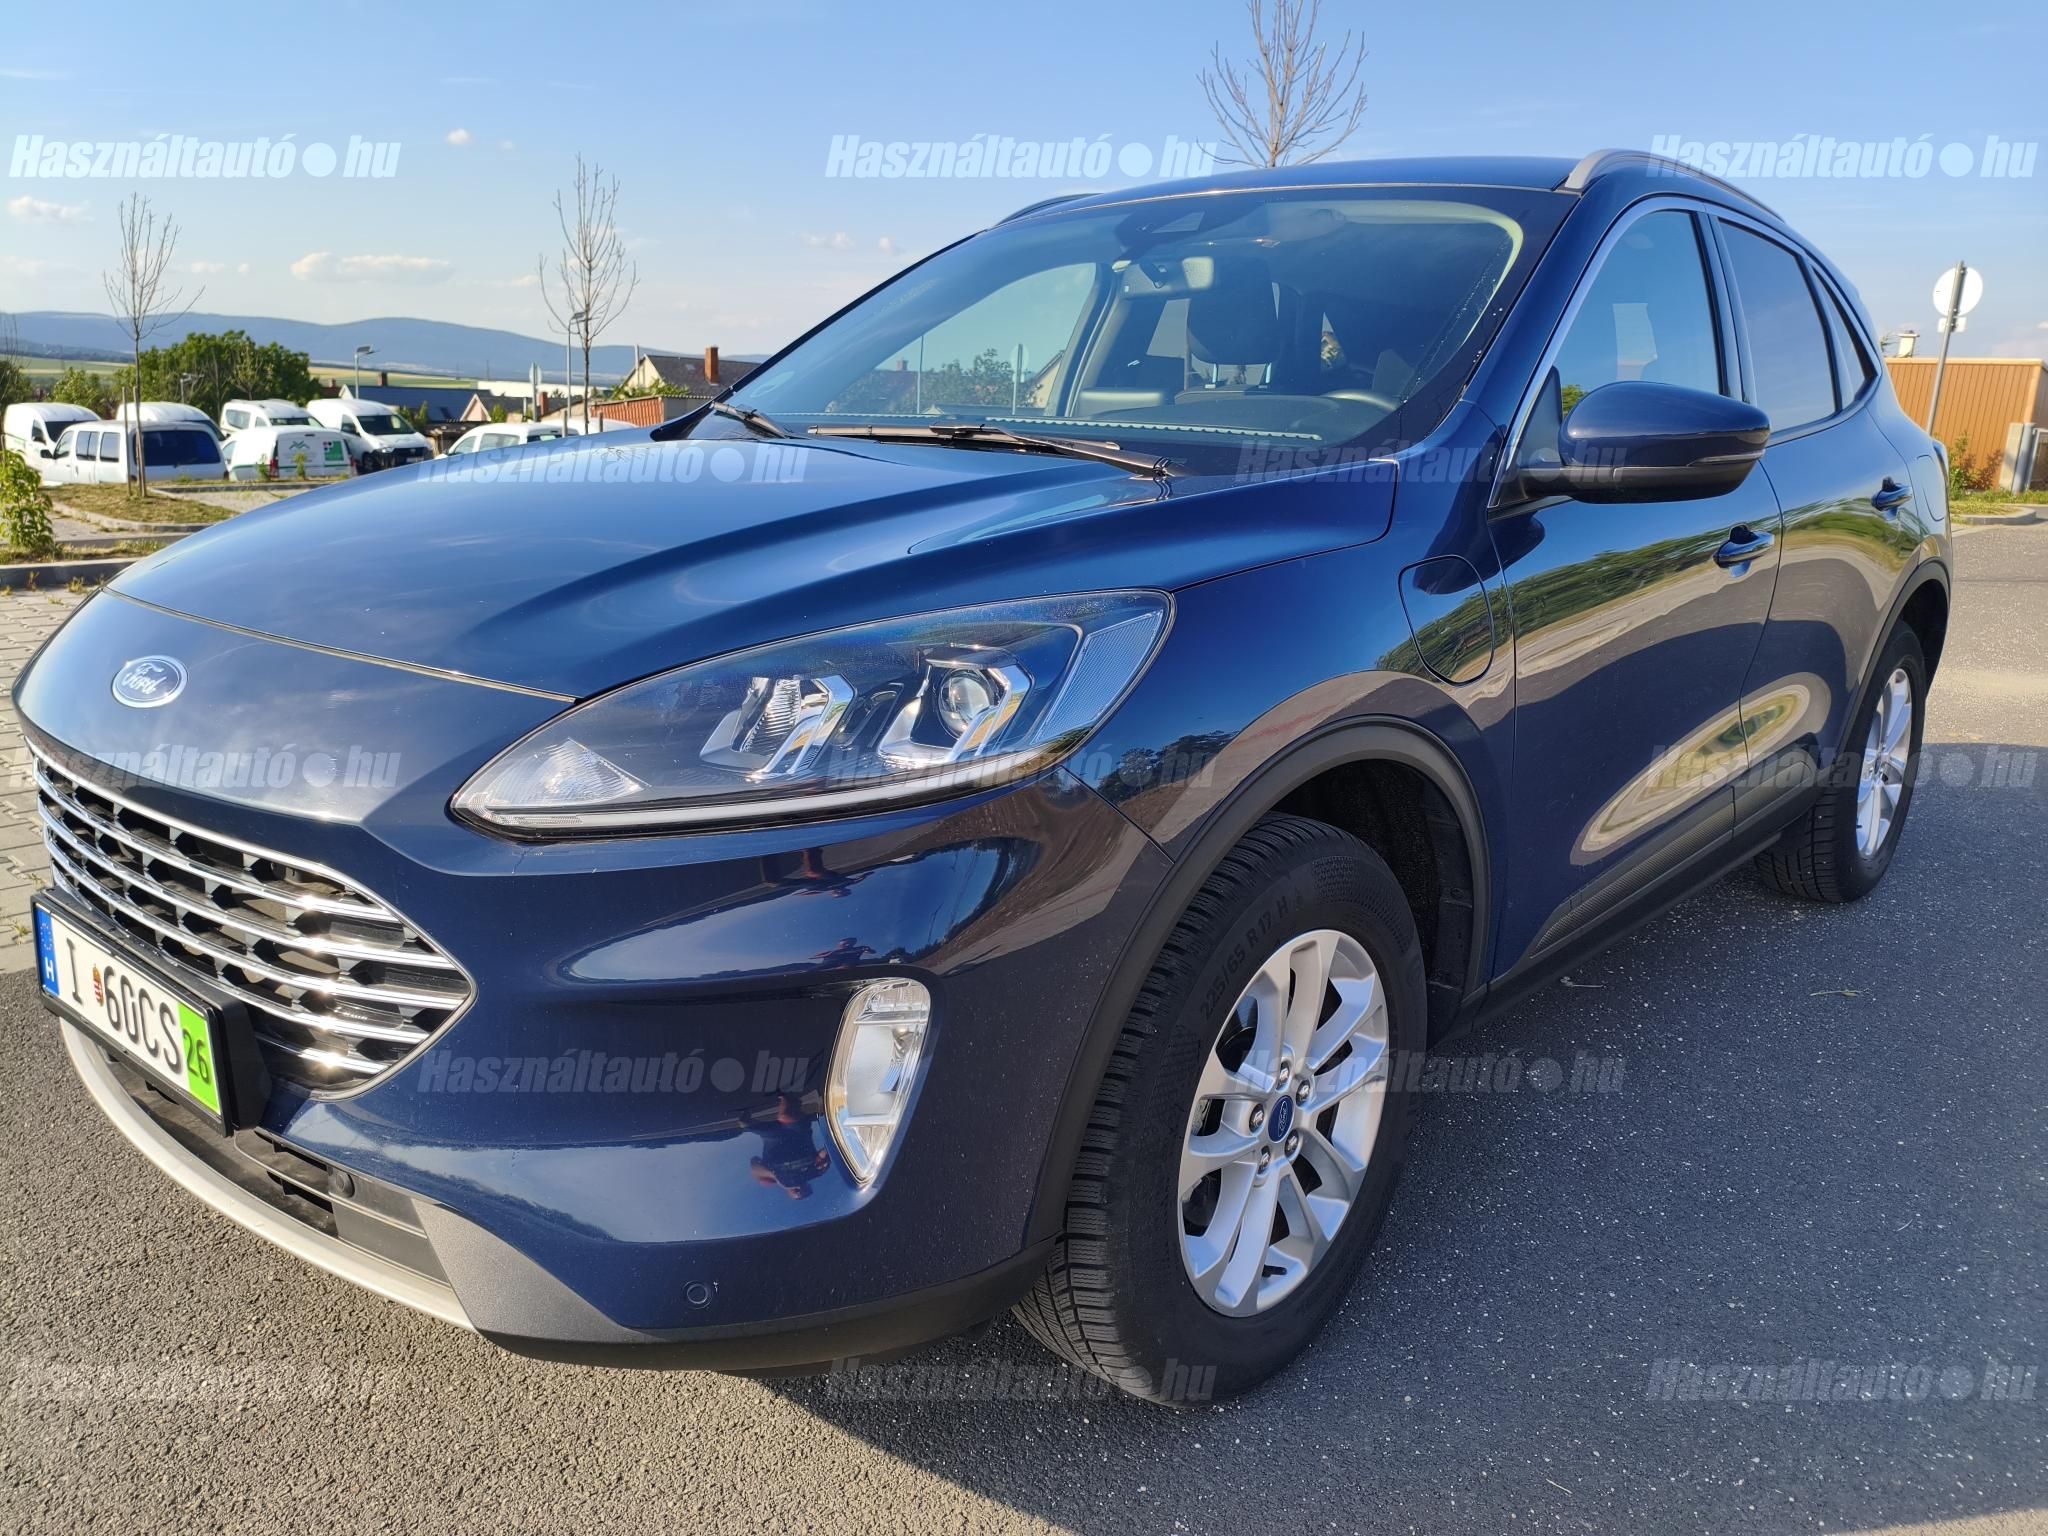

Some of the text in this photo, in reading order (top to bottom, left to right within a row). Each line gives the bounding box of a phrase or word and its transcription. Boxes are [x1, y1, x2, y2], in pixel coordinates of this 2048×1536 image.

[121, 662, 167, 695] Ford
[44, 956, 55, 982] H
[1200, 943, 1246, 1021] 225/65
[182, 1028, 210, 1085] 26
